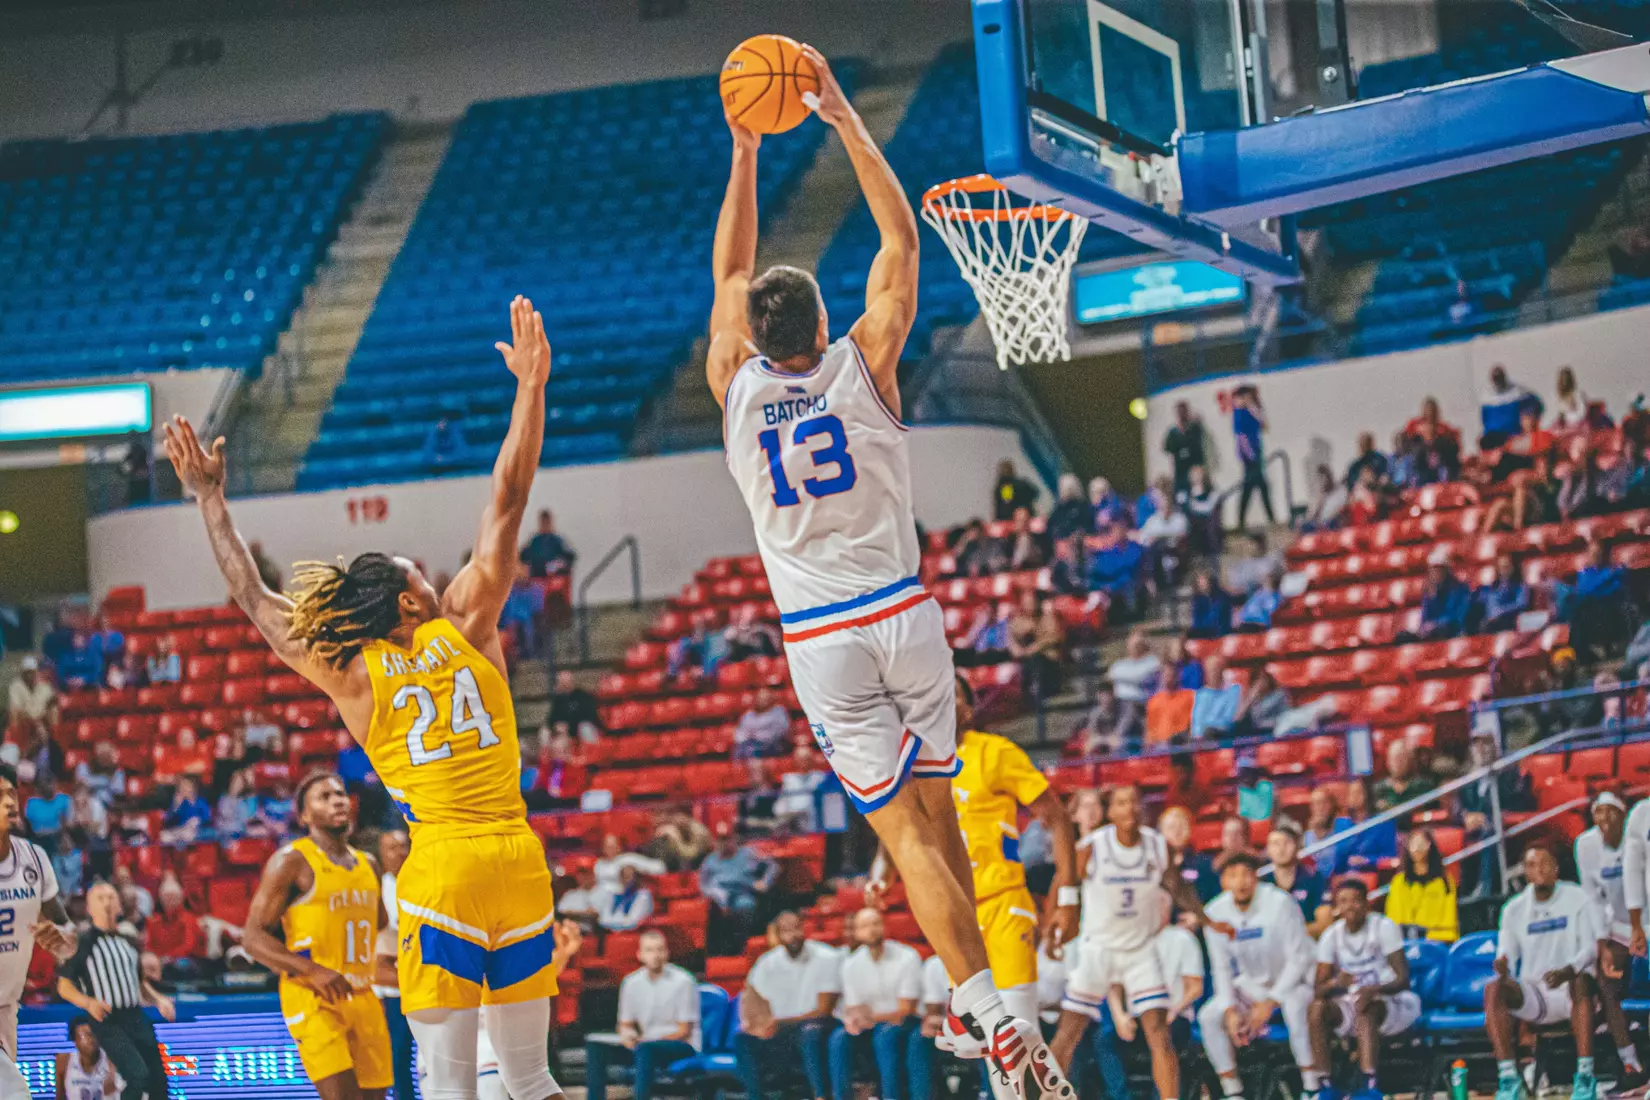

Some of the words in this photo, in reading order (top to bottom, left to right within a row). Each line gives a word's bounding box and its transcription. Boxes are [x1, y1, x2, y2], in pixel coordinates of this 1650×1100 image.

[763, 394, 828, 425] BATCHO
[758, 413, 858, 508] 13
[392, 666, 500, 767] 24
[1121, 888, 1134, 908] 3
[346, 919, 371, 964] 13
